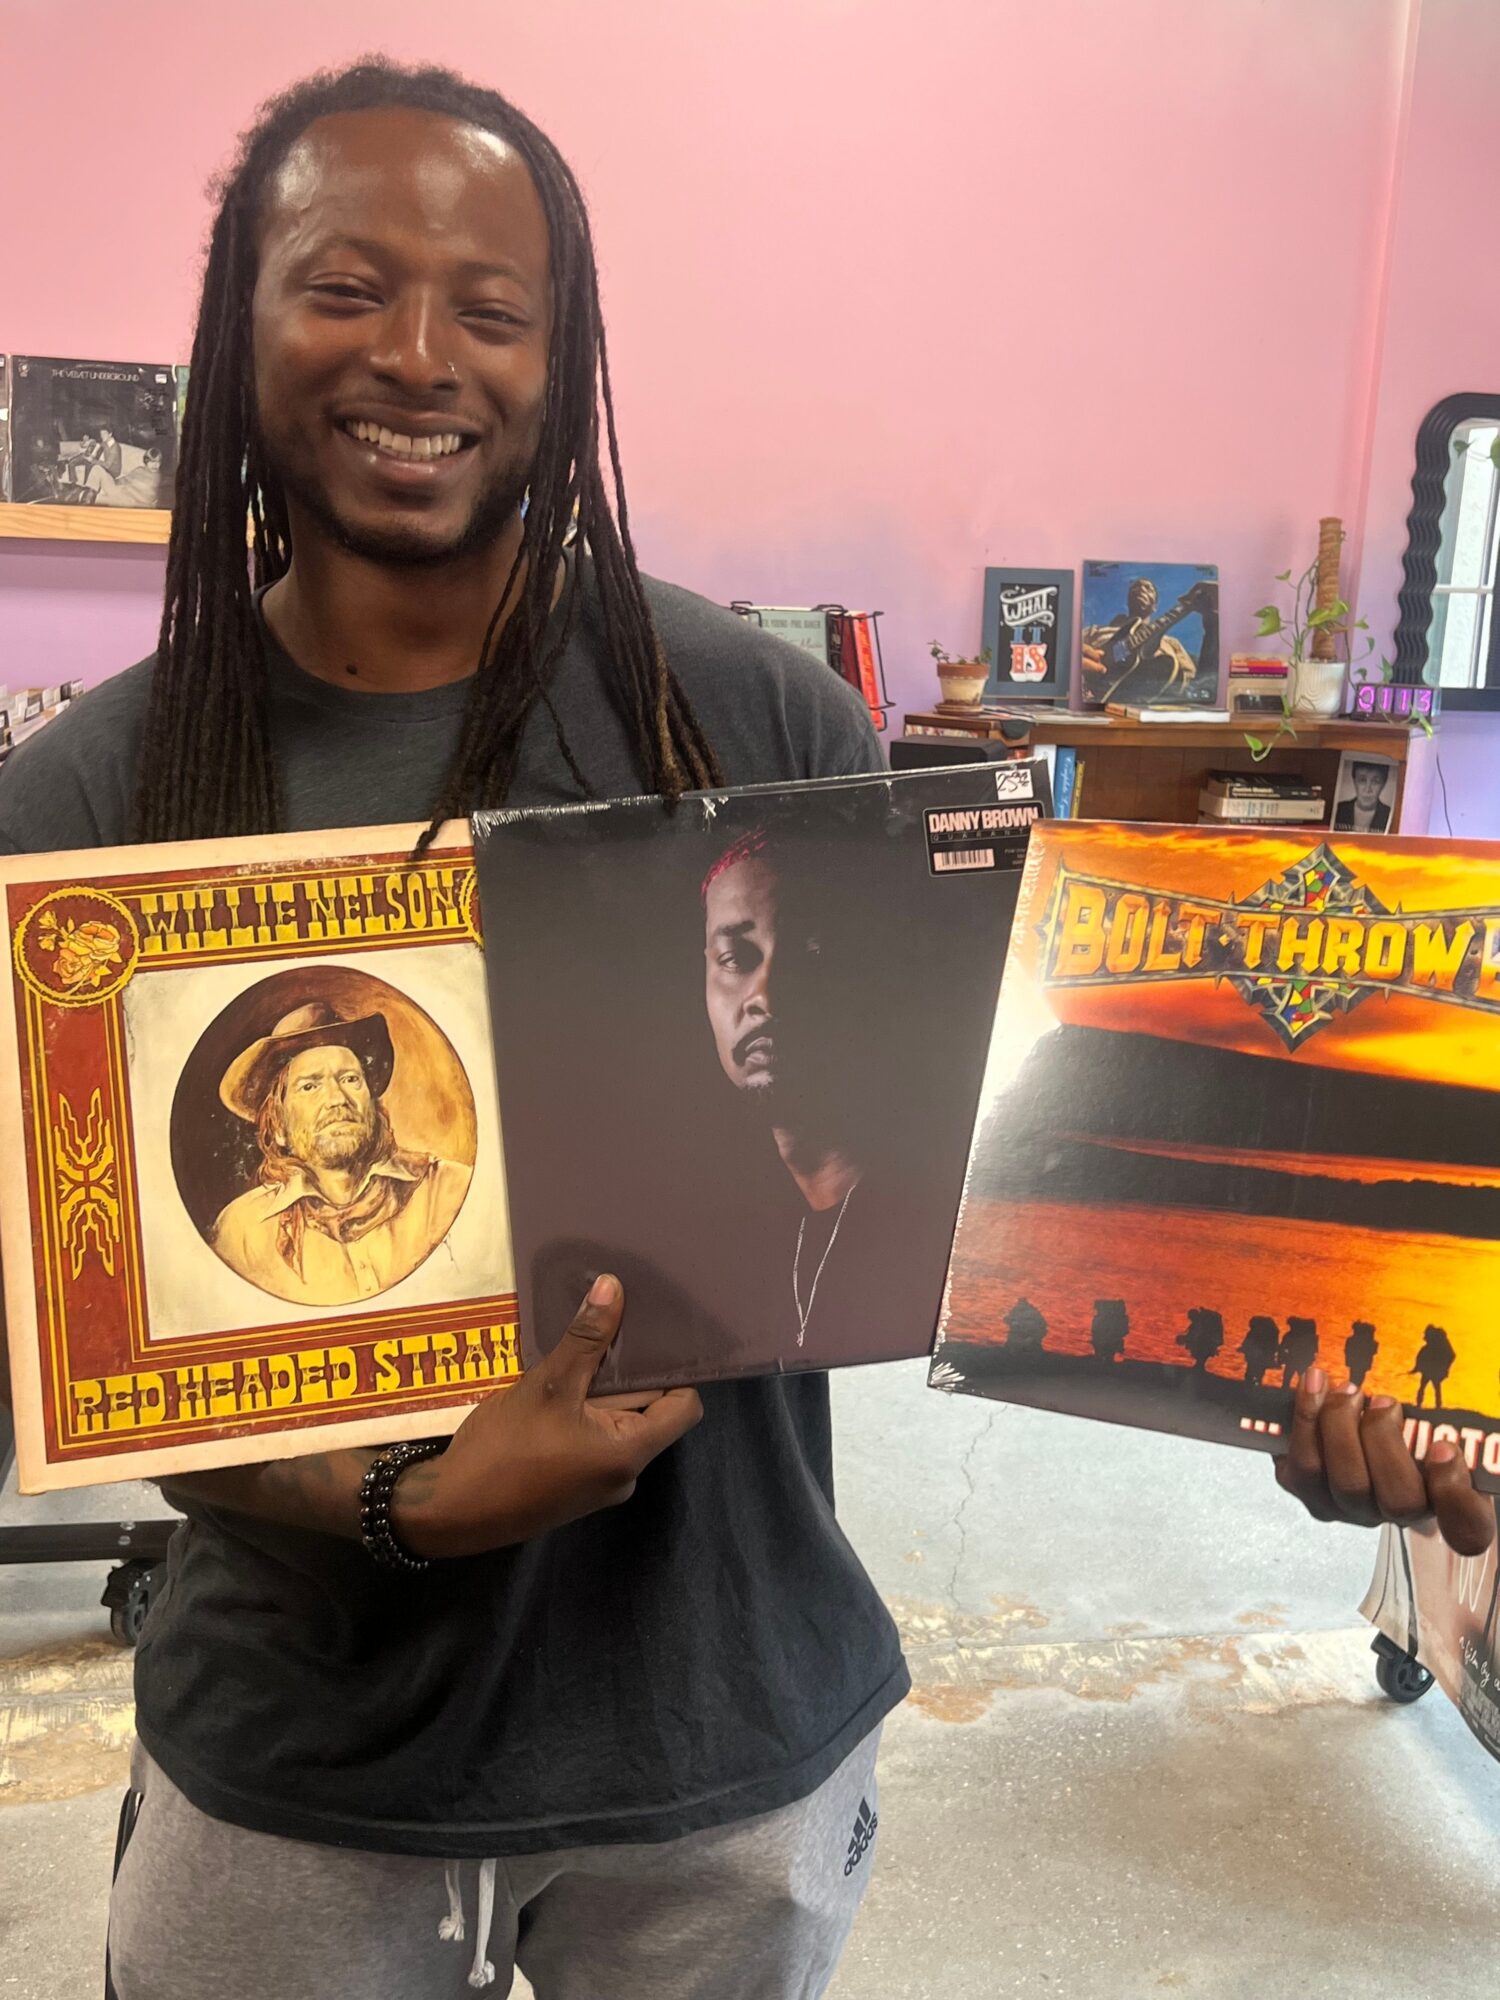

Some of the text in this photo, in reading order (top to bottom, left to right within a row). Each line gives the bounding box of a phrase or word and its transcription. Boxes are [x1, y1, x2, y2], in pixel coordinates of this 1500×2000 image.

[51, 369, 140, 382] THE VELVET UNDERGROUND
[1001, 588, 1053, 622] WHAT
[1010, 626, 1046, 644] IT
[1009, 643, 1048, 682] IS
[928, 811, 980, 833] DANNY
[981, 807, 1039, 829] BROWN
[141, 869, 458, 954] WILLIE NELSON
[1050, 881, 1221, 978] BOLT
[373, 1323, 518, 1394] STRAN
[843, 1811, 878, 1877] adidas
